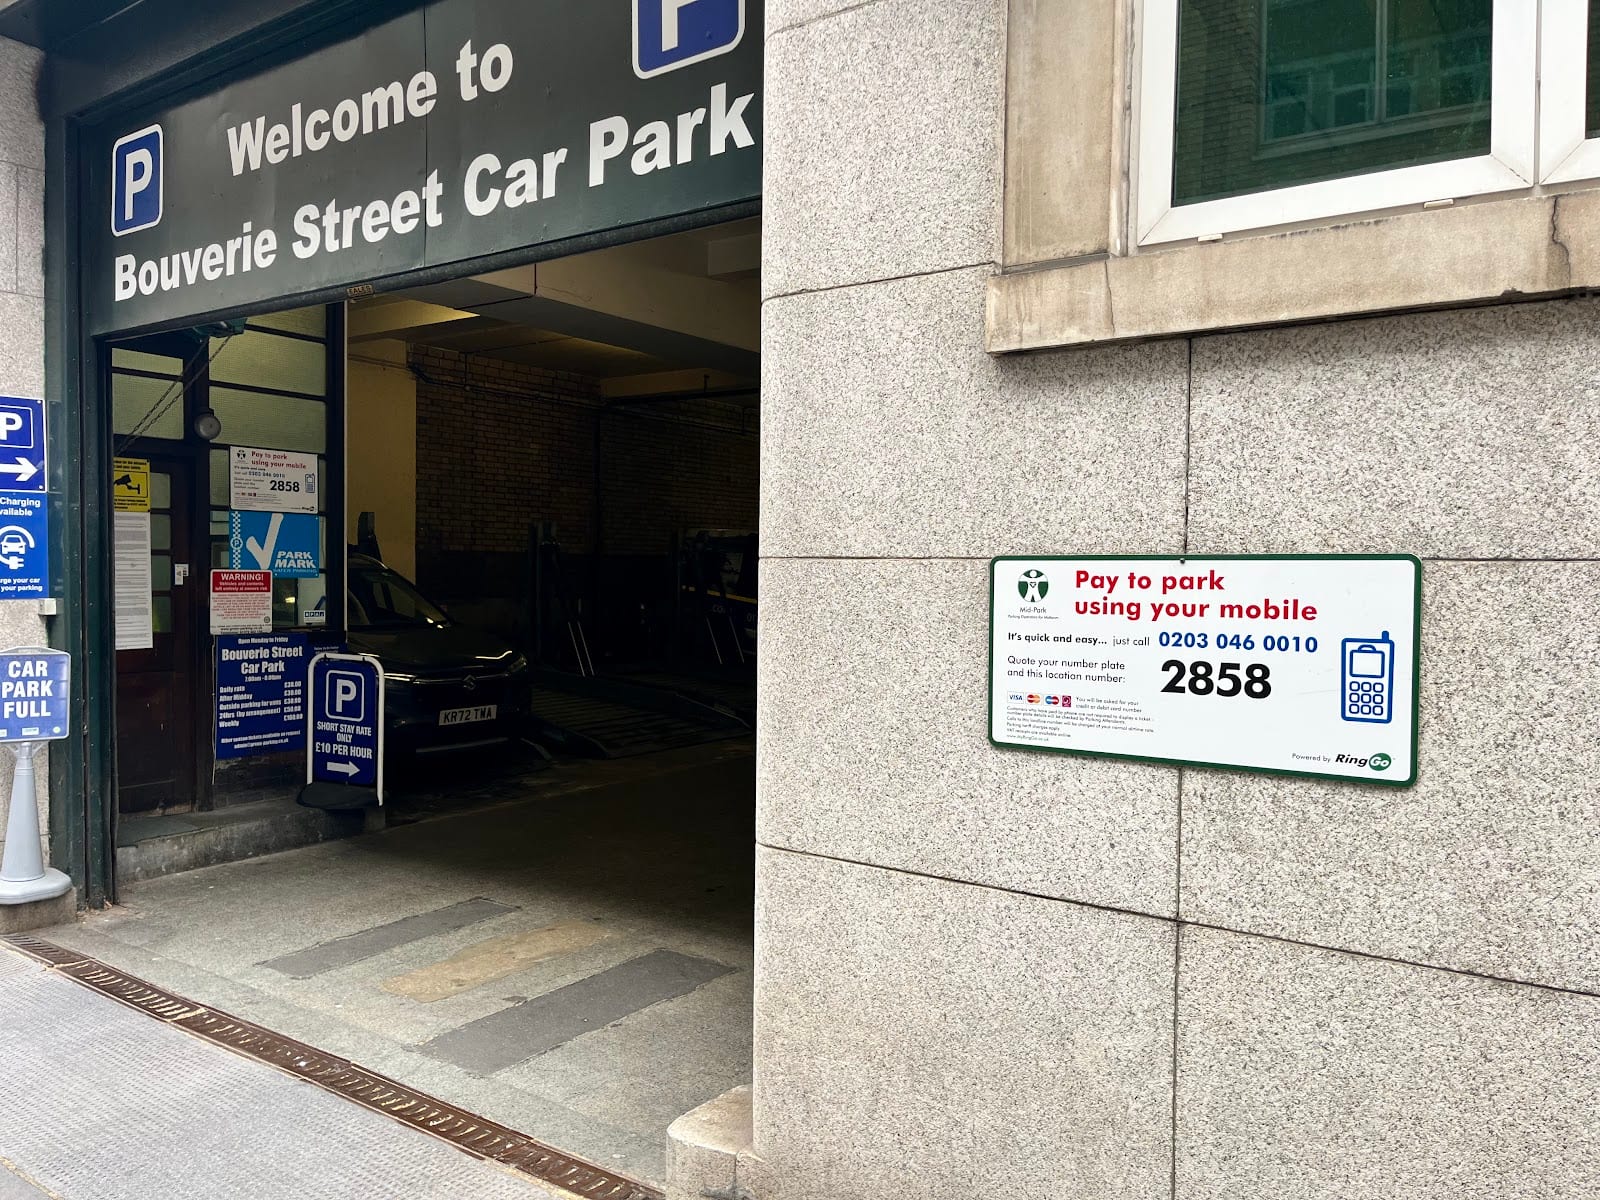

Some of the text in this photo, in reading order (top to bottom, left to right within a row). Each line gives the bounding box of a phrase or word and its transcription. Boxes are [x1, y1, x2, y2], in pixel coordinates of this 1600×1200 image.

[227, 41, 514, 176] Welcome to
[114, 83, 755, 301] Bouverie Street Car Park
[125, 153, 153, 221] P
[270, 480, 300, 492] 2858
[0, 497, 40, 508] Charging
[0, 508, 32, 516] vailable
[277, 551, 312, 559] PARK
[275, 559, 316, 568] MARK
[1076, 570, 1225, 594] Pay to park
[1075, 596, 1318, 621] using your mobile
[1008, 632, 1318, 652] It's quick and easy... just call 0203 046 0010
[222, 646, 303, 661] Bouverie Street
[8, 660, 48, 678] CAR
[241, 660, 285, 674] Car Park
[1008, 656, 1125, 671] Quote your number plate
[1008, 668, 1125, 683] and this location number:
[1160, 659, 1272, 699] 2858
[2, 680, 53, 698] PARK
[336, 679, 356, 712] P
[4, 700, 52, 718] FULL
[444, 710, 471, 723] KR72
[317, 721, 372, 736] SHORT STAY RATE
[336, 733, 352, 743] ONLY
[316, 742, 372, 759] £10 PER HOUR
[1292, 753, 1320, 761] Powered
